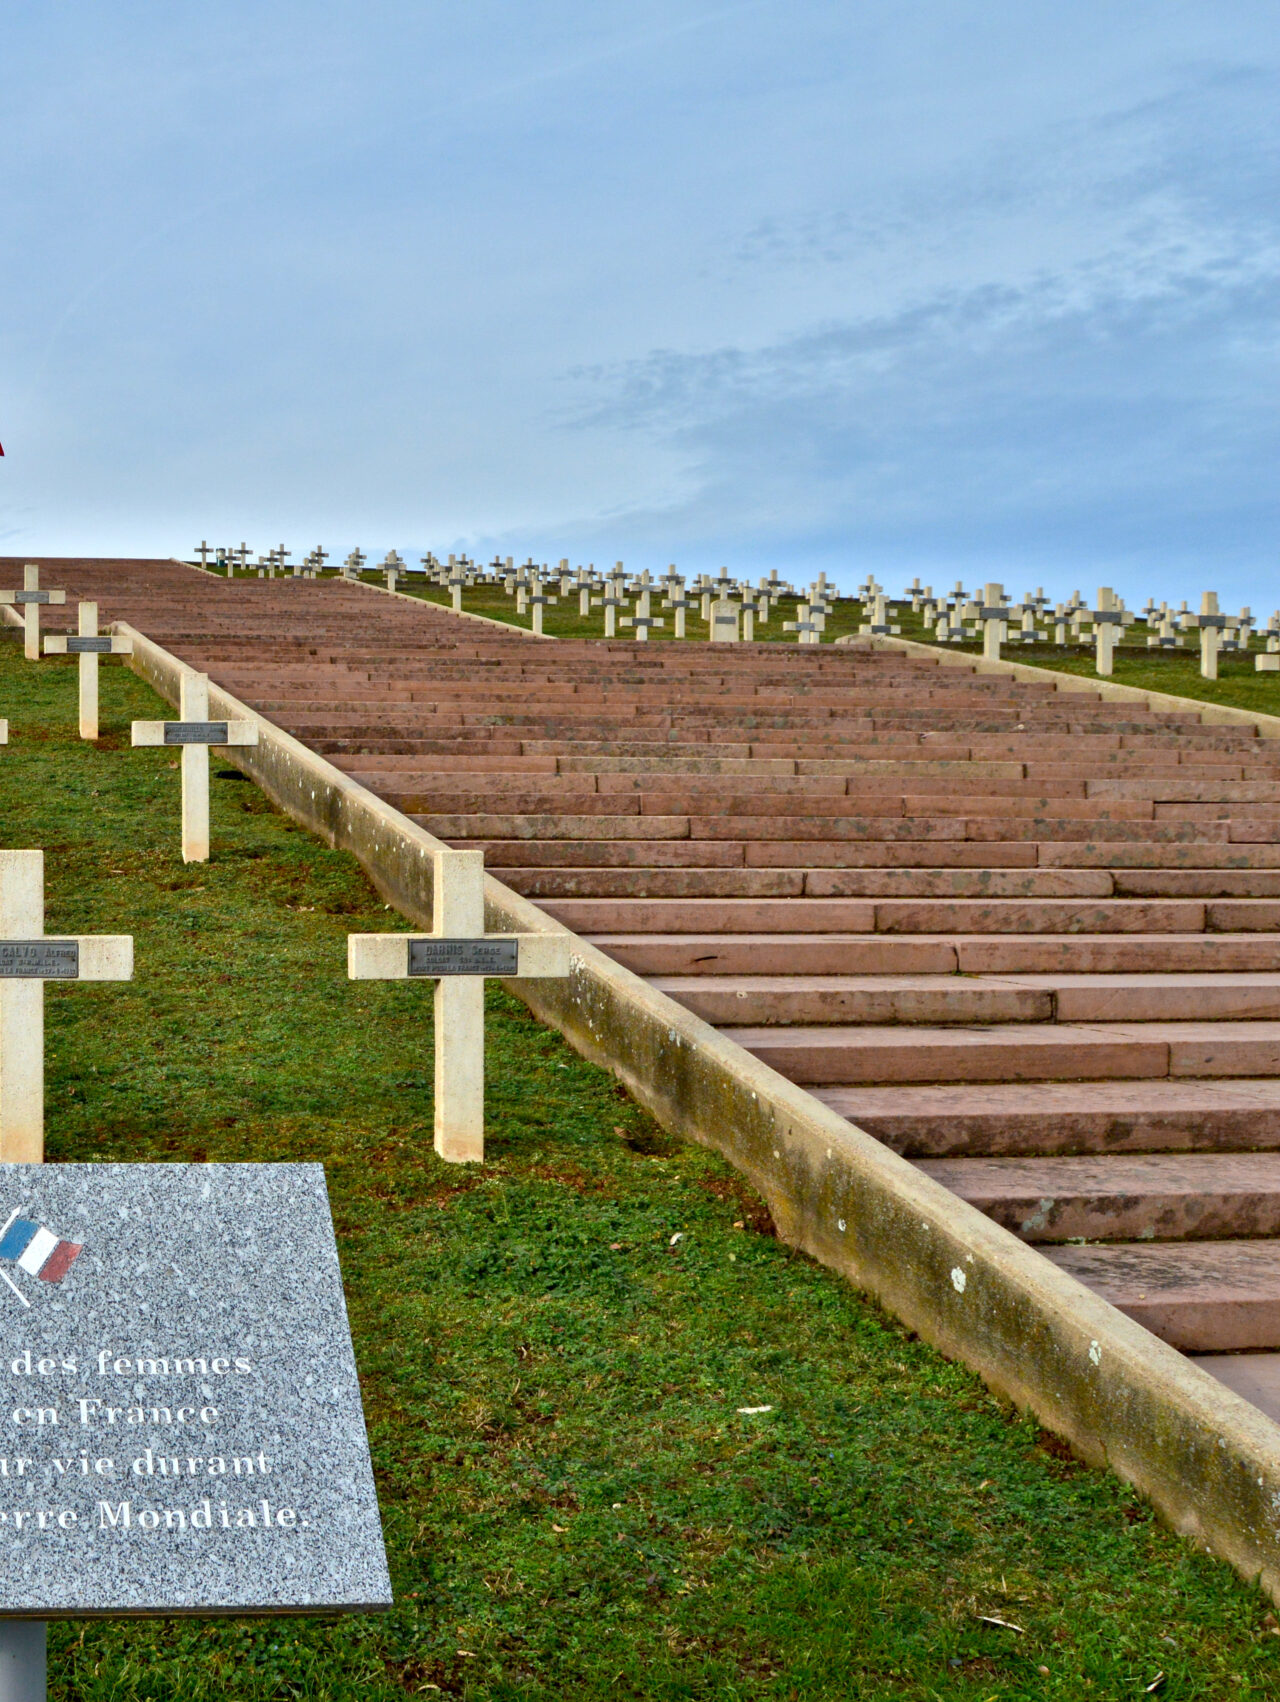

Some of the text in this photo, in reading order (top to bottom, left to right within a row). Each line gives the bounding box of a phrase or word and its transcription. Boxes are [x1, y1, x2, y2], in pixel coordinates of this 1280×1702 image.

[11, 1350, 78, 1376] des
[97, 1350, 252, 1376] femmes
[12, 1406, 60, 1425] en
[75, 1398, 220, 1425] France
[53, 1449, 114, 1476] vie
[132, 1449, 272, 1476] durant
[97, 1499, 309, 1530] Mondiale.
